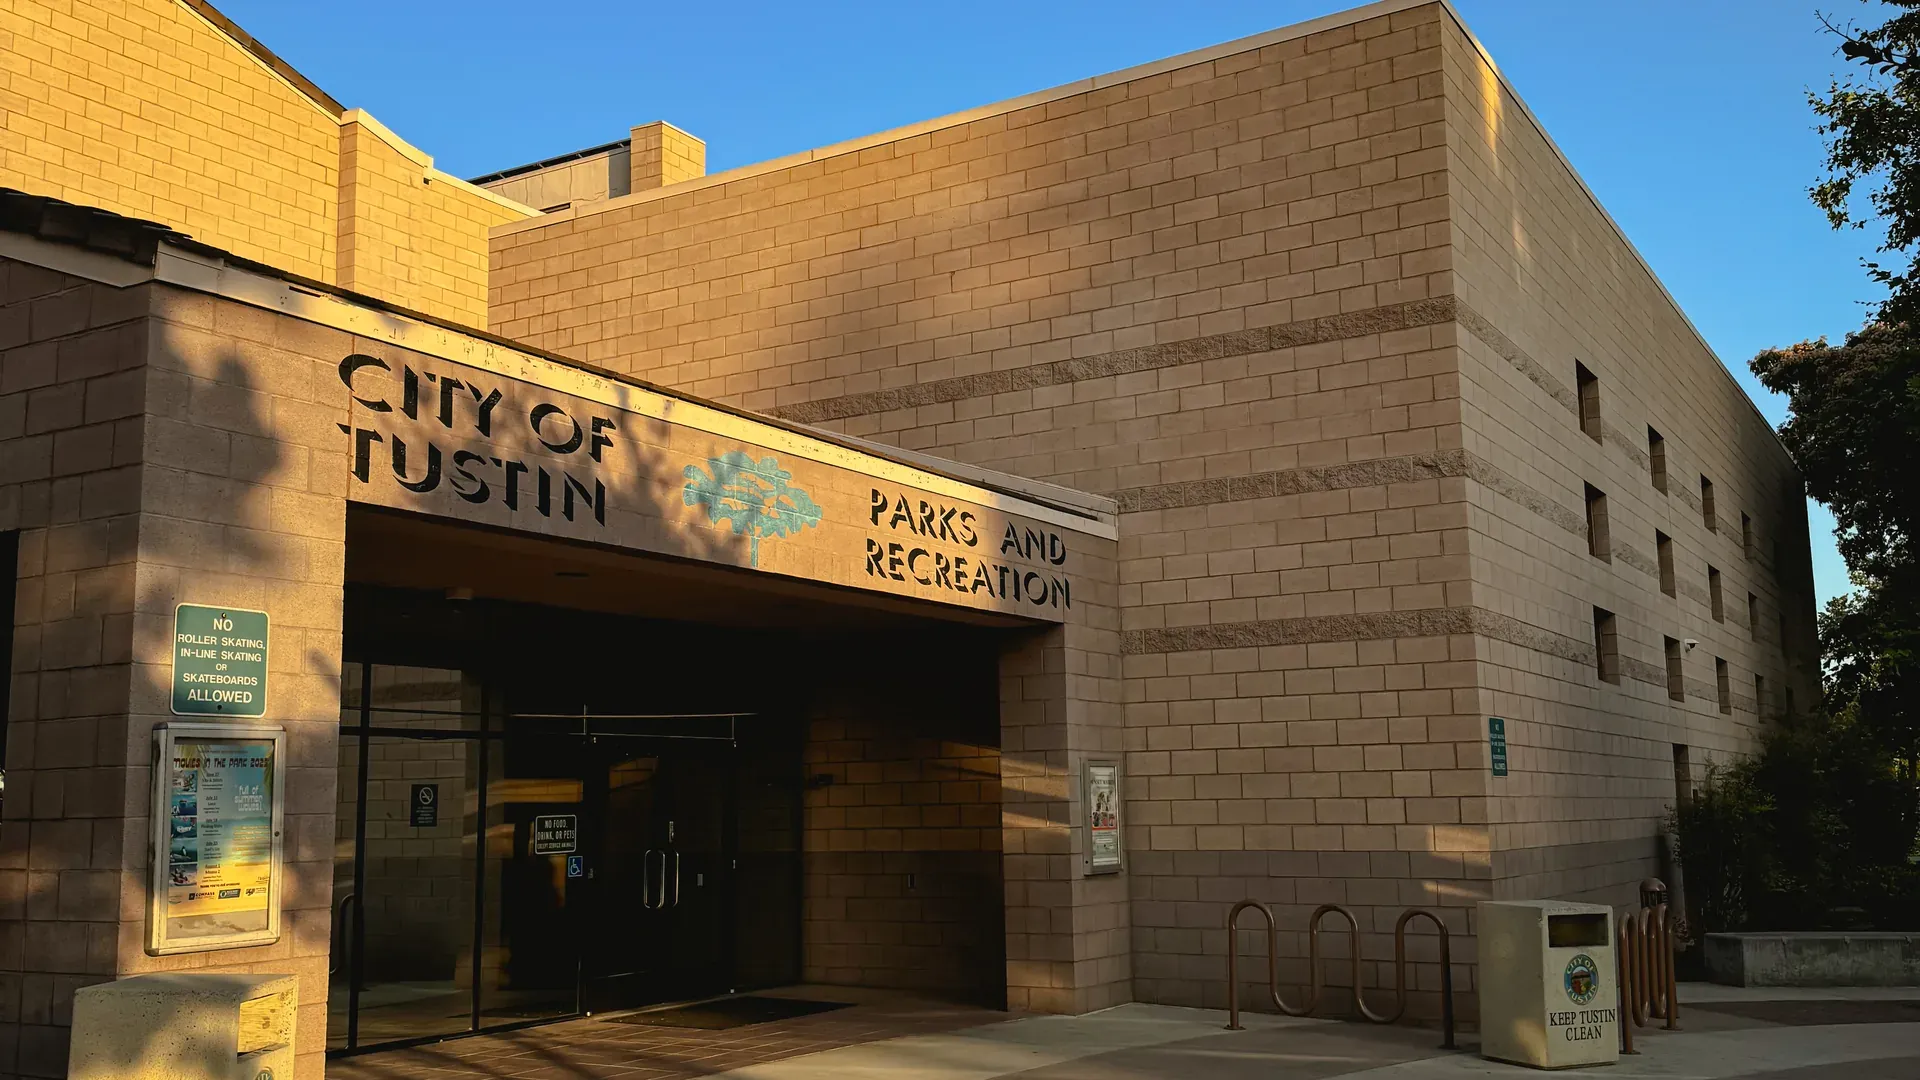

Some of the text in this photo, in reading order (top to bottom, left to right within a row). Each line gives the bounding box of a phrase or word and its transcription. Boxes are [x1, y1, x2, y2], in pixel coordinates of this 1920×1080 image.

[338, 354, 617, 463] CITY OF
[336, 423, 606, 527] TUSTIN
[869, 488, 1067, 566] PARKS AND
[865, 538, 1071, 609] RECREATION
[213, 618, 233, 631] NO
[178, 634, 265, 650] ROLLER SKATING,
[181, 648, 262, 662] IN-LINE SKATING
[216, 663, 227, 671] OR
[183, 673, 258, 686] SKATEBOARDS
[187, 689, 252, 703] ALLOWED
[214, 758, 226, 768] THE
[544, 820, 552, 828] NO
[555, 831, 562, 840] OR
[563, 830, 575, 839] PETS
[1566, 957, 1583, 975] CITY
[1567, 984, 1596, 1004] TUSTIN
[1549, 1009, 1616, 1026] KEEP TUSTIN
[1565, 1025, 1602, 1041] CLEAN
